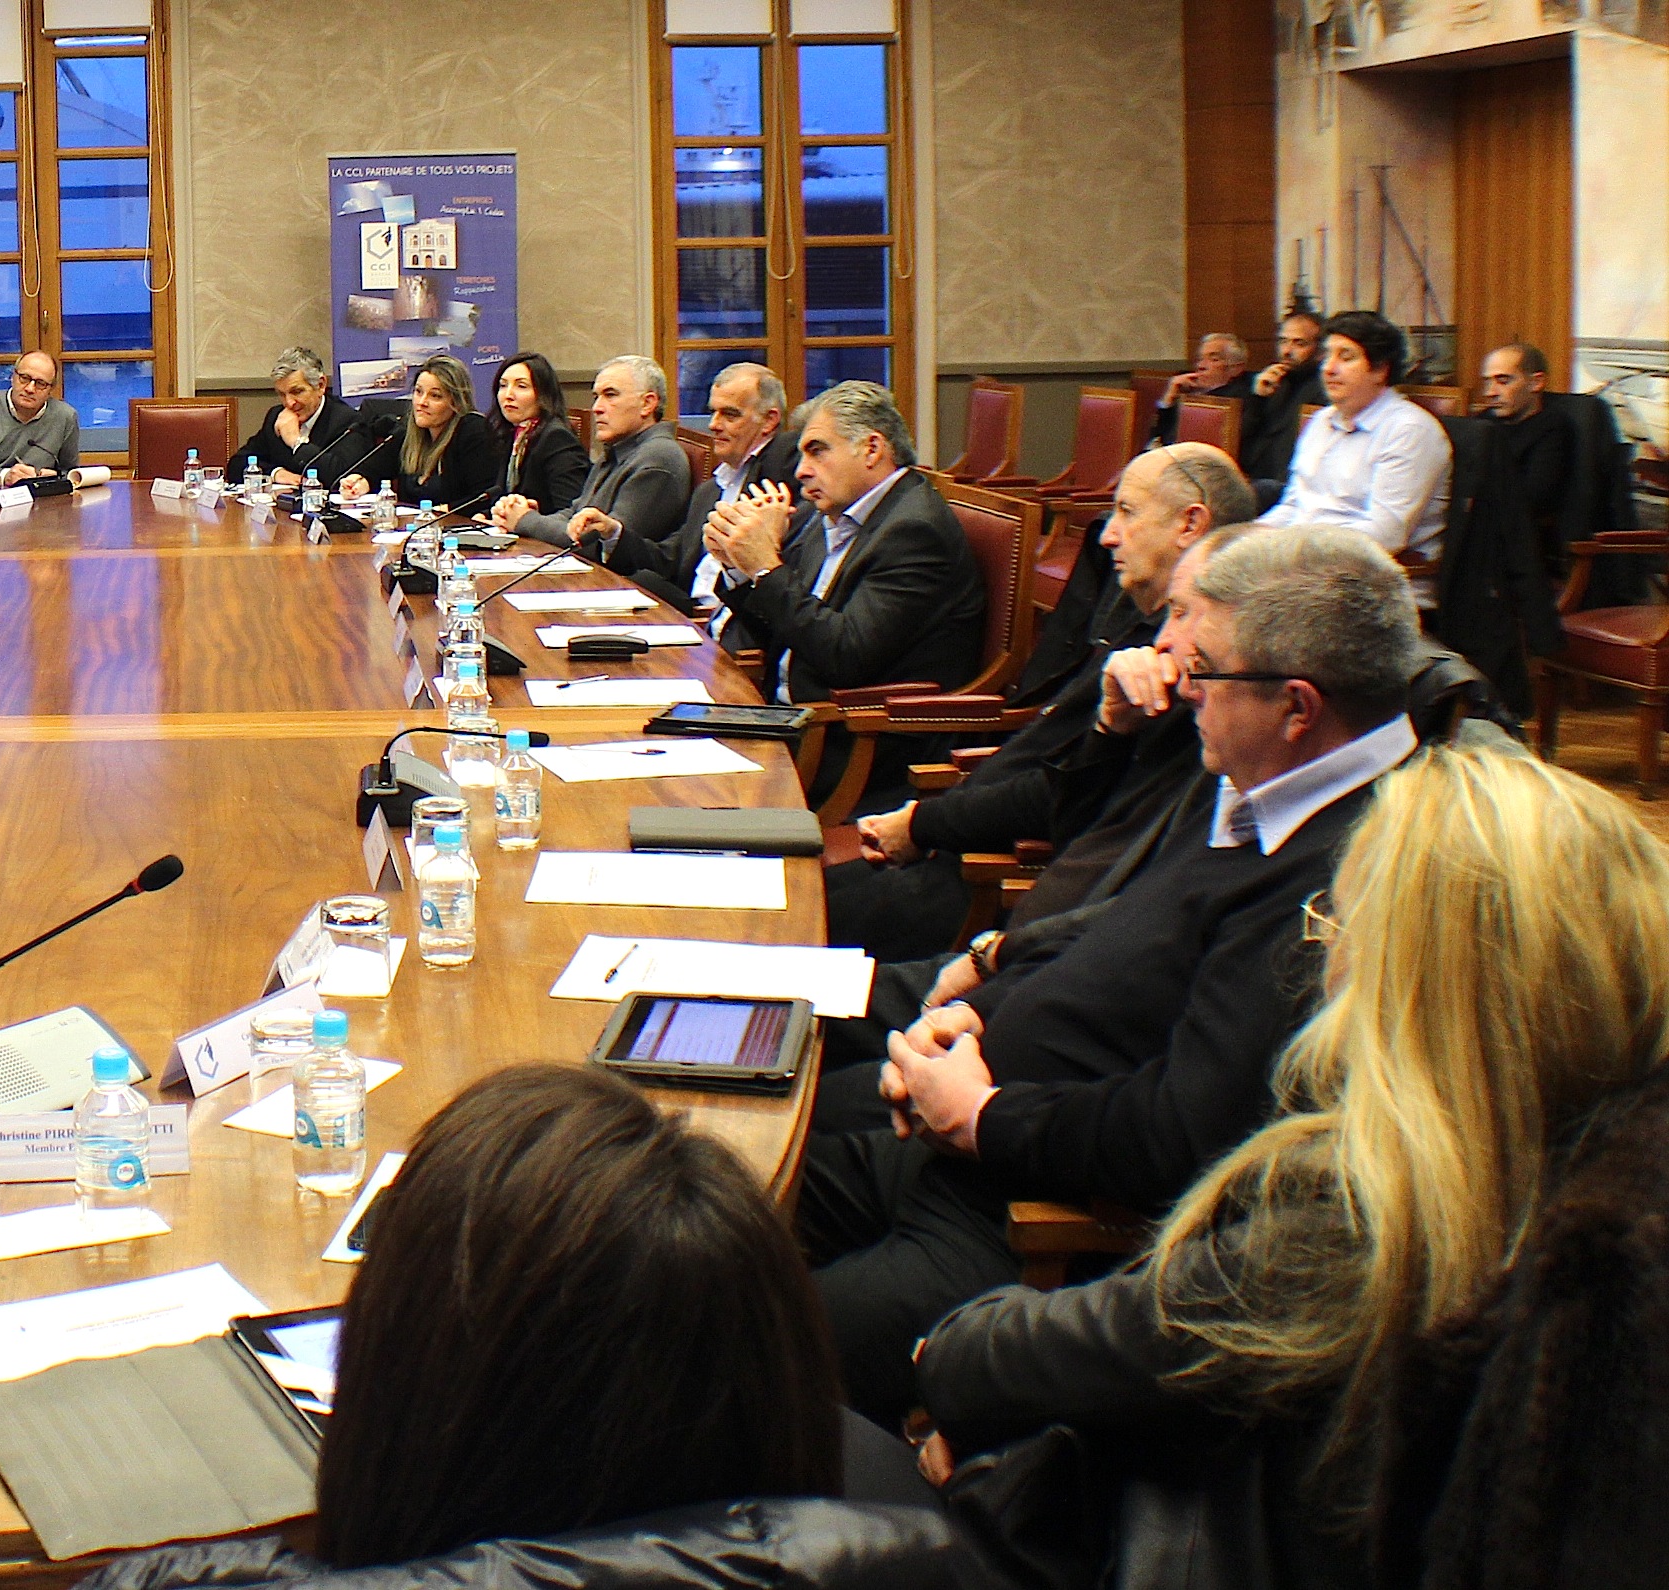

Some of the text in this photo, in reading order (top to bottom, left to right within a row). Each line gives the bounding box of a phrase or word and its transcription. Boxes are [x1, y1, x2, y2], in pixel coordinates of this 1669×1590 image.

[331, 168, 343, 177] LA
[365, 166, 414, 177] PARTENAIRE
[415, 165, 428, 175] DE
[429, 164, 454, 175] TOUS
[454, 164, 475, 175] VOS
[476, 163, 514, 175] PROJETS
[370, 263, 391, 271] CCI
[24, 1143, 65, 1154] Membre
